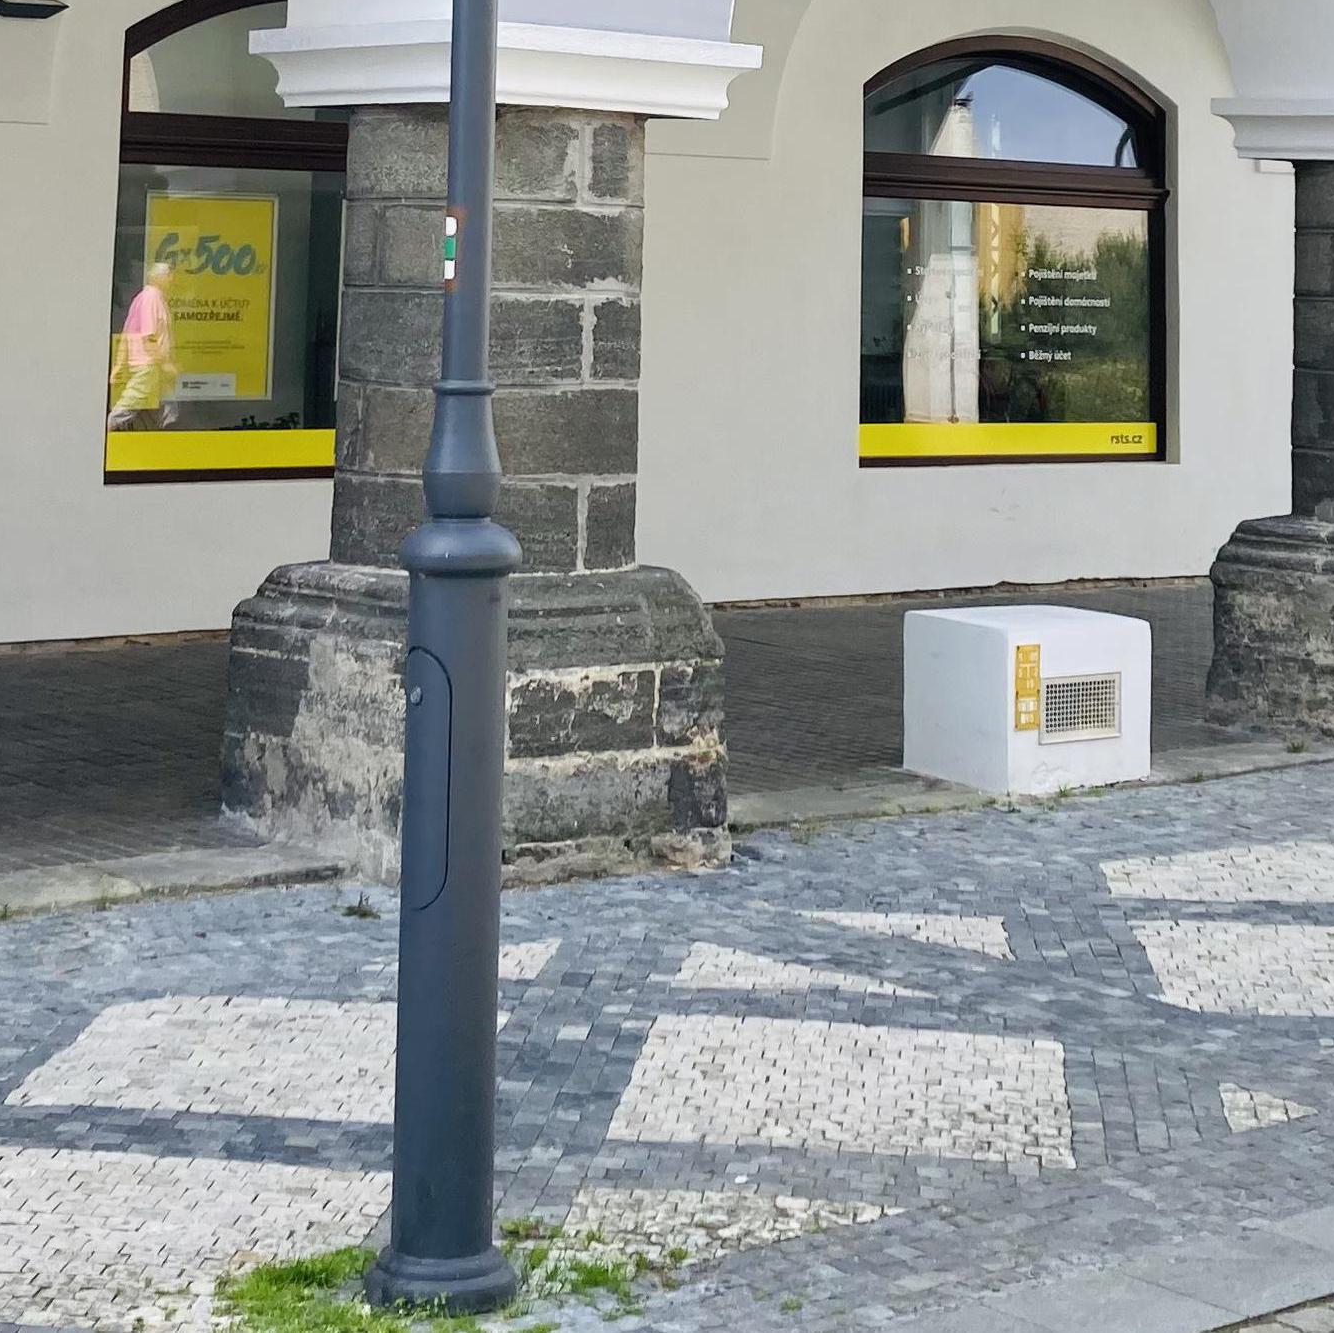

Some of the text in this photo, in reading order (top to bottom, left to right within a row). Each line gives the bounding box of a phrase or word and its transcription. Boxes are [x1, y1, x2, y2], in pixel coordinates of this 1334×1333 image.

[1028, 296, 1063, 308] Pojištění
[1060, 324, 1097, 336] produkty
[1028, 349, 1053, 362] Běžný
[1110, 434, 1143, 444] rsts.cz
